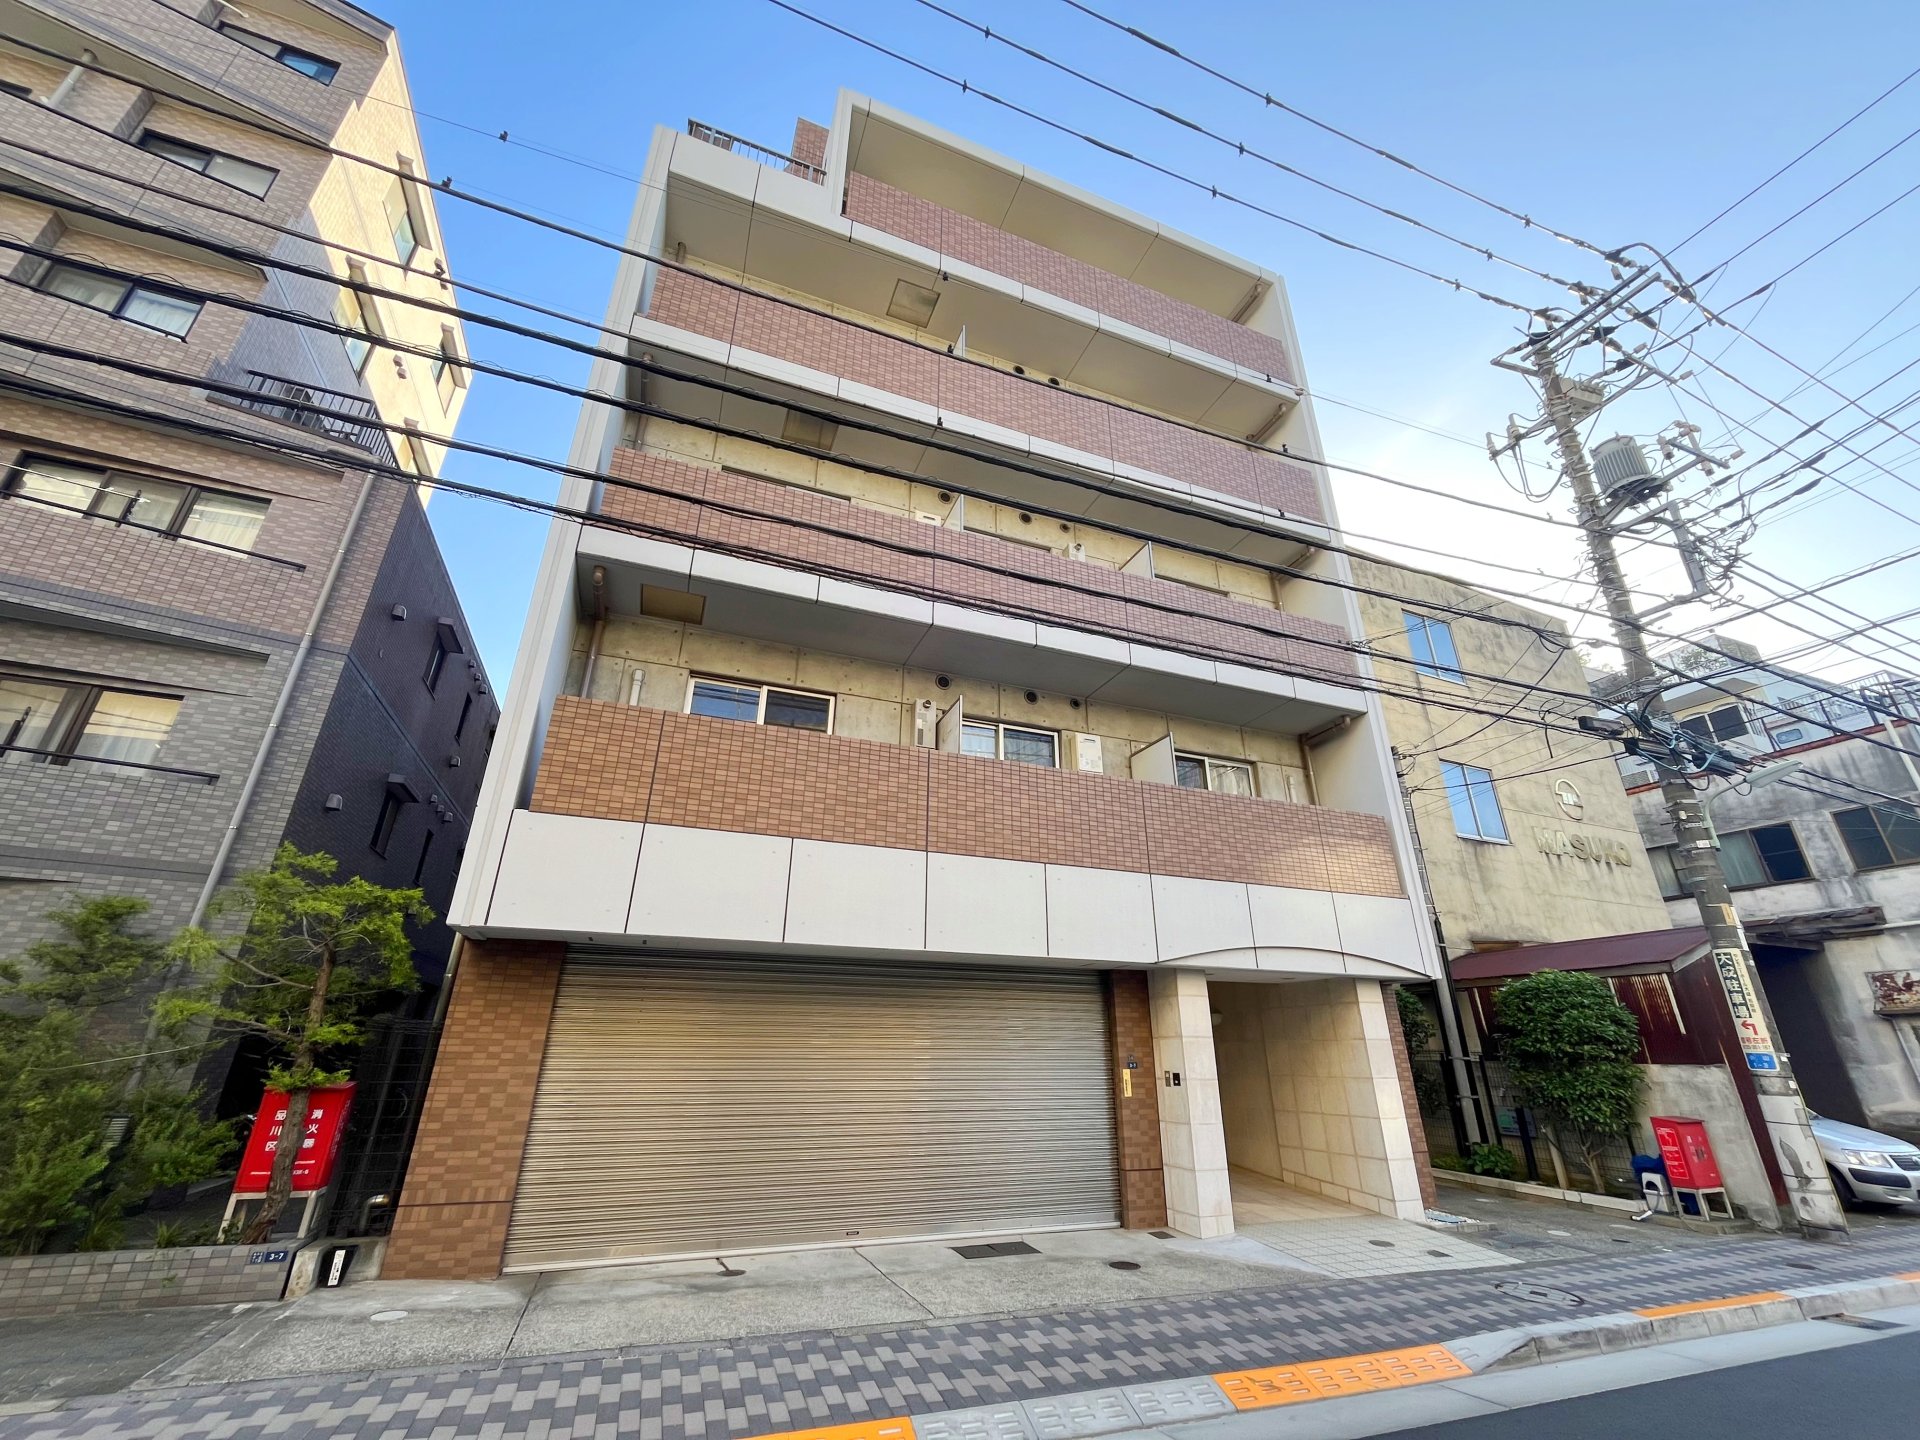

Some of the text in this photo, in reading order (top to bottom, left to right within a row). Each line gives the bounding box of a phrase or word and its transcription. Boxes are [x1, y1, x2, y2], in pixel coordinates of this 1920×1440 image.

[1531, 825, 1632, 867] MASUKO
[1717, 953, 1750, 1018] 大成駐車場
[265, 1109, 287, 1151] 品川区
[302, 1109, 324, 1149] 消火器
[269, 1252, 285, 1261] 3-7
